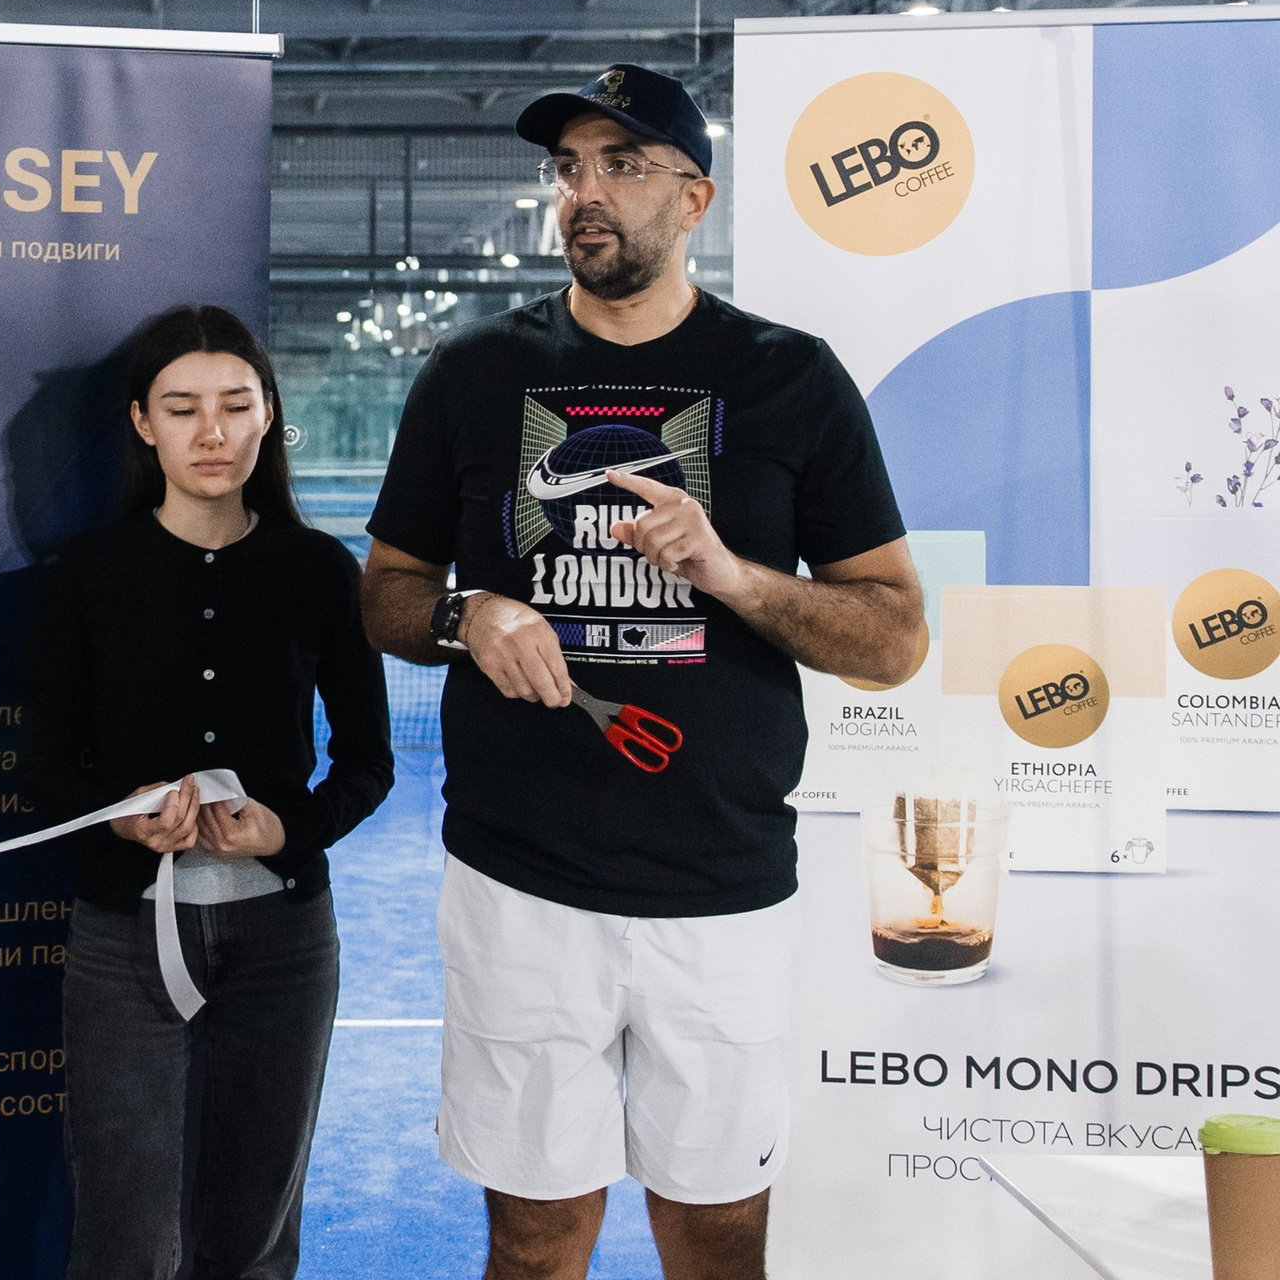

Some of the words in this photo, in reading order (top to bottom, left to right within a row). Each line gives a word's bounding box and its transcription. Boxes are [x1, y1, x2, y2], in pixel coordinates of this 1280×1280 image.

[809, 120, 940, 208] LEBO
[894, 161, 955, 198] COFFEE
[10, 239, 121, 263] подвиги
[573, 504, 647, 550] RUN
[530, 553, 695, 609] LONDON
[1188, 599, 1268, 650] LEBO
[1240, 624, 1277, 646] COFFEE
[1015, 673, 1090, 720] LEBO
[1063, 697, 1099, 716] COFFEE
[1177, 694, 1280, 710] COLOMBIA
[842, 706, 904, 720] BRAZIL
[829, 722, 918, 737] MOGIANA
[1011, 762, 1097, 777] ETHIOPIA
[802, 791, 837, 799] COFFEE
[993, 778, 1113, 795] YIRGACHEFFE
[1066, 801, 1101, 809] ARABICA
[1110, 850, 1121, 864] 6
[821, 1050, 949, 1088] LEBO
[965, 1055, 1119, 1095] MONO
[1136, 1061, 1280, 1100] DRIPS
[0, 1092, 66, 1117] сост
[923, 1116, 1074, 1146] ЧИСТОТА
[888, 1153, 993, 1183] ПРОС
